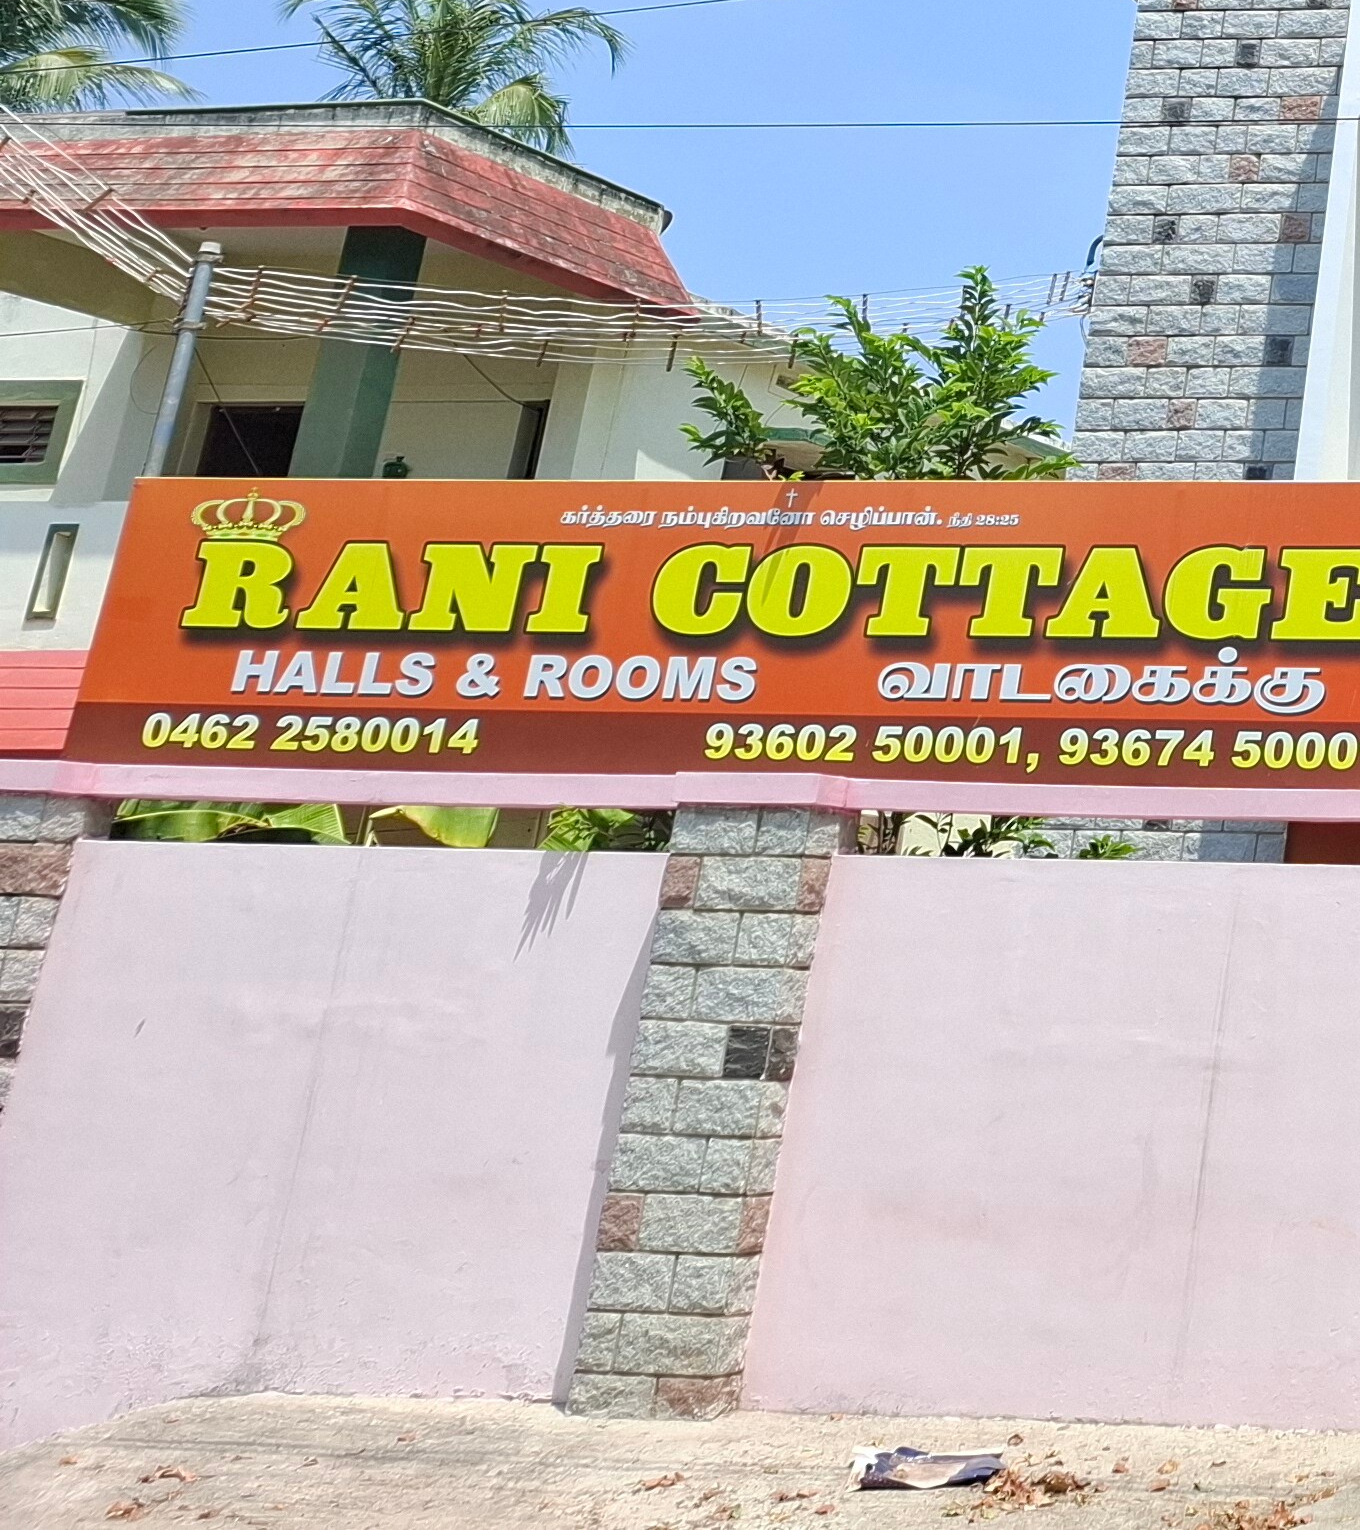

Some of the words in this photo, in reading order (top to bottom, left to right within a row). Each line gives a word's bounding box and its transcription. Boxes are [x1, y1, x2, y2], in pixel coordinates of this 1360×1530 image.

[559, 504, 656, 529] கர்த்தரை
[658, 505, 816, 530] நம்புகிறவனோ
[819, 505, 943, 531] செழிப்பான்.
[975, 513, 1019, 526] 28:25
[180, 540, 604, 634] RANI
[230, 649, 437, 697] HALLS
[455, 655, 502, 698] &
[523, 654, 757, 701] ROOMS
[877, 646, 1326, 714] வாடகைக்கு
[141, 712, 260, 751] 0462
[271, 714, 480, 755] 2580014
[704, 722, 858, 763] 93602
[871, 725, 1041, 774] 50001,
[1057, 727, 1215, 768] 93674
